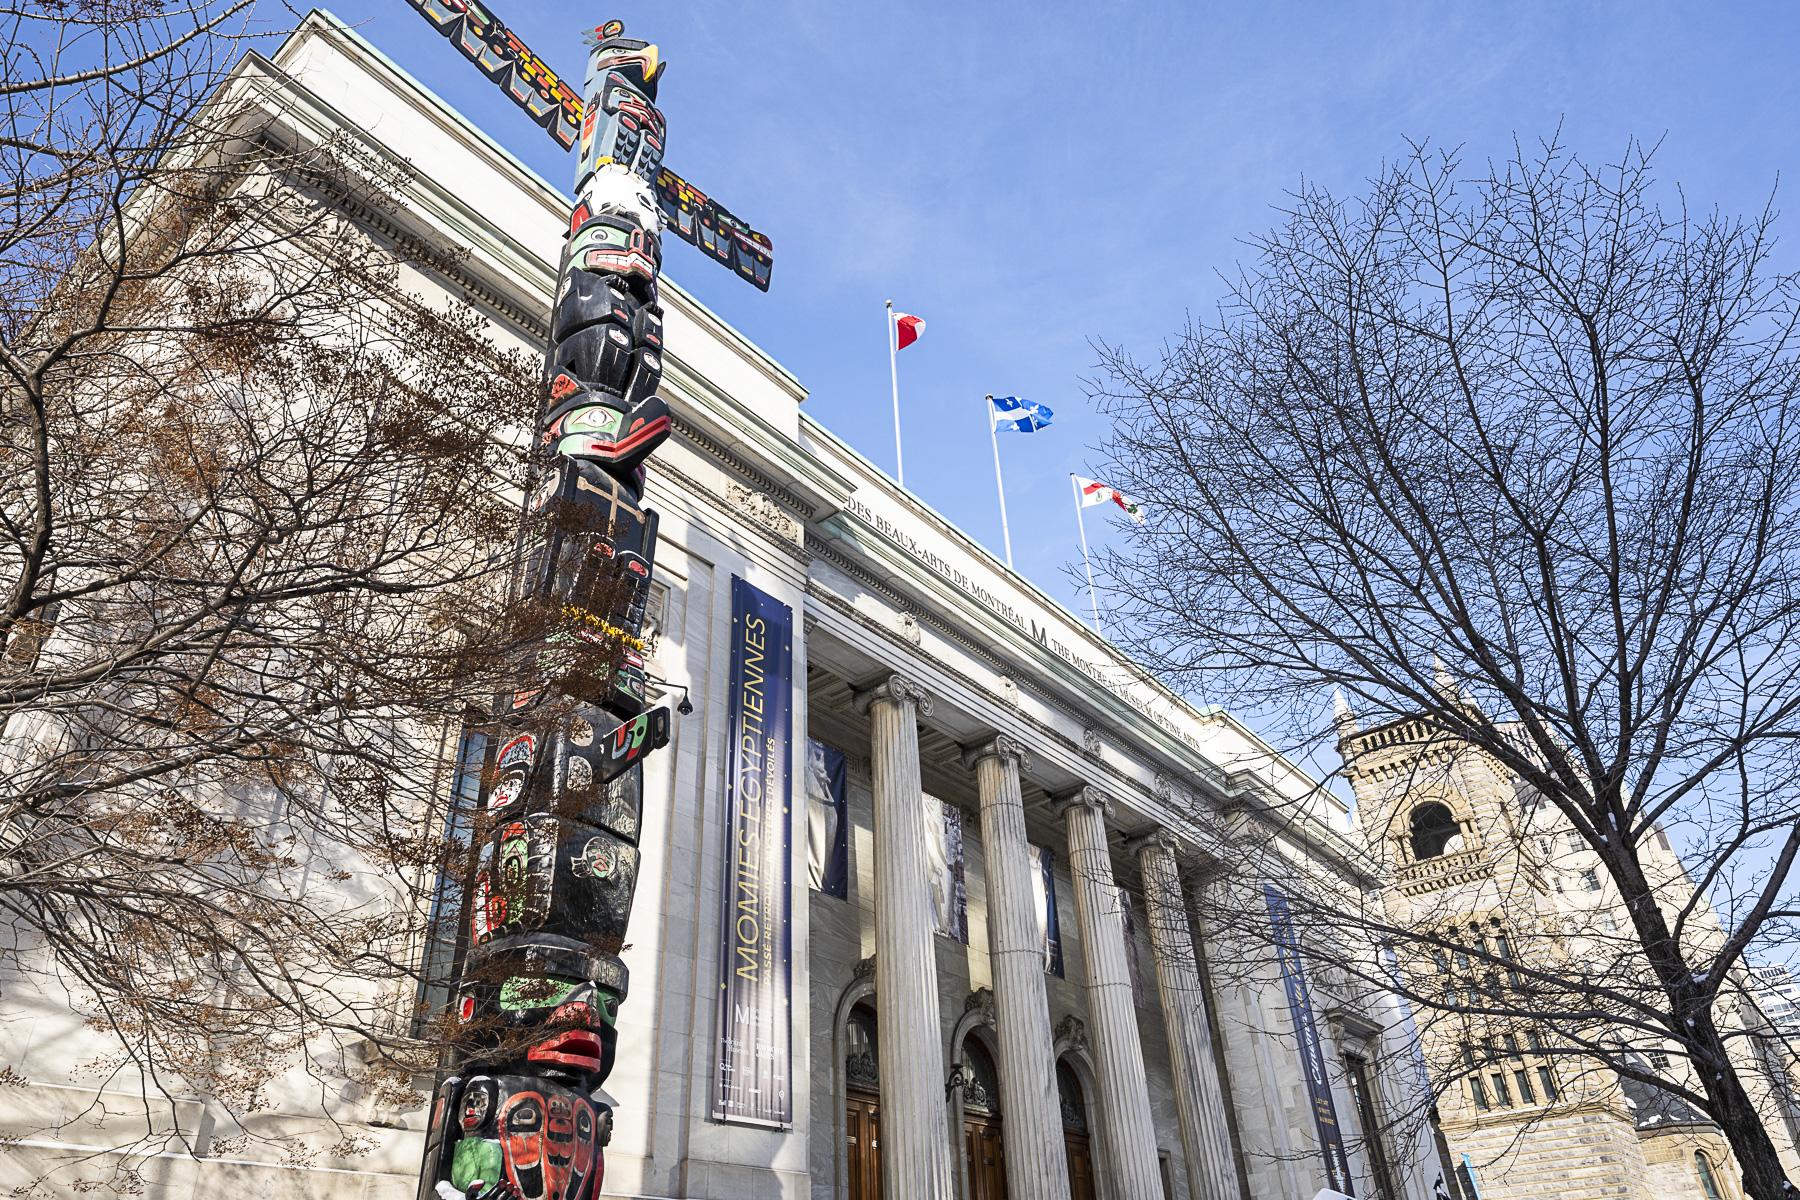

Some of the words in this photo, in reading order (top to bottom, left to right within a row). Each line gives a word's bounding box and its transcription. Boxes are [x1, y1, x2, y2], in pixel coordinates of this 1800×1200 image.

[847, 495, 872, 522] DES
[876, 514, 952, 577] BEAUX-ARTS
[953, 568, 969, 590] DE
[971, 581, 1027, 630] MONTRÉAL
[1031, 618, 1048, 648] M
[1051, 638, 1071, 661] THE
[1165, 717, 1181, 738] FINE
[1183, 731, 1201, 751] ARTS
[765, 737, 775, 796] DÉVOILÉS
[736, 829, 761, 982] MOMIES
[762, 943, 772, 986] PASSÉ
[735, 1003, 750, 1025] M
